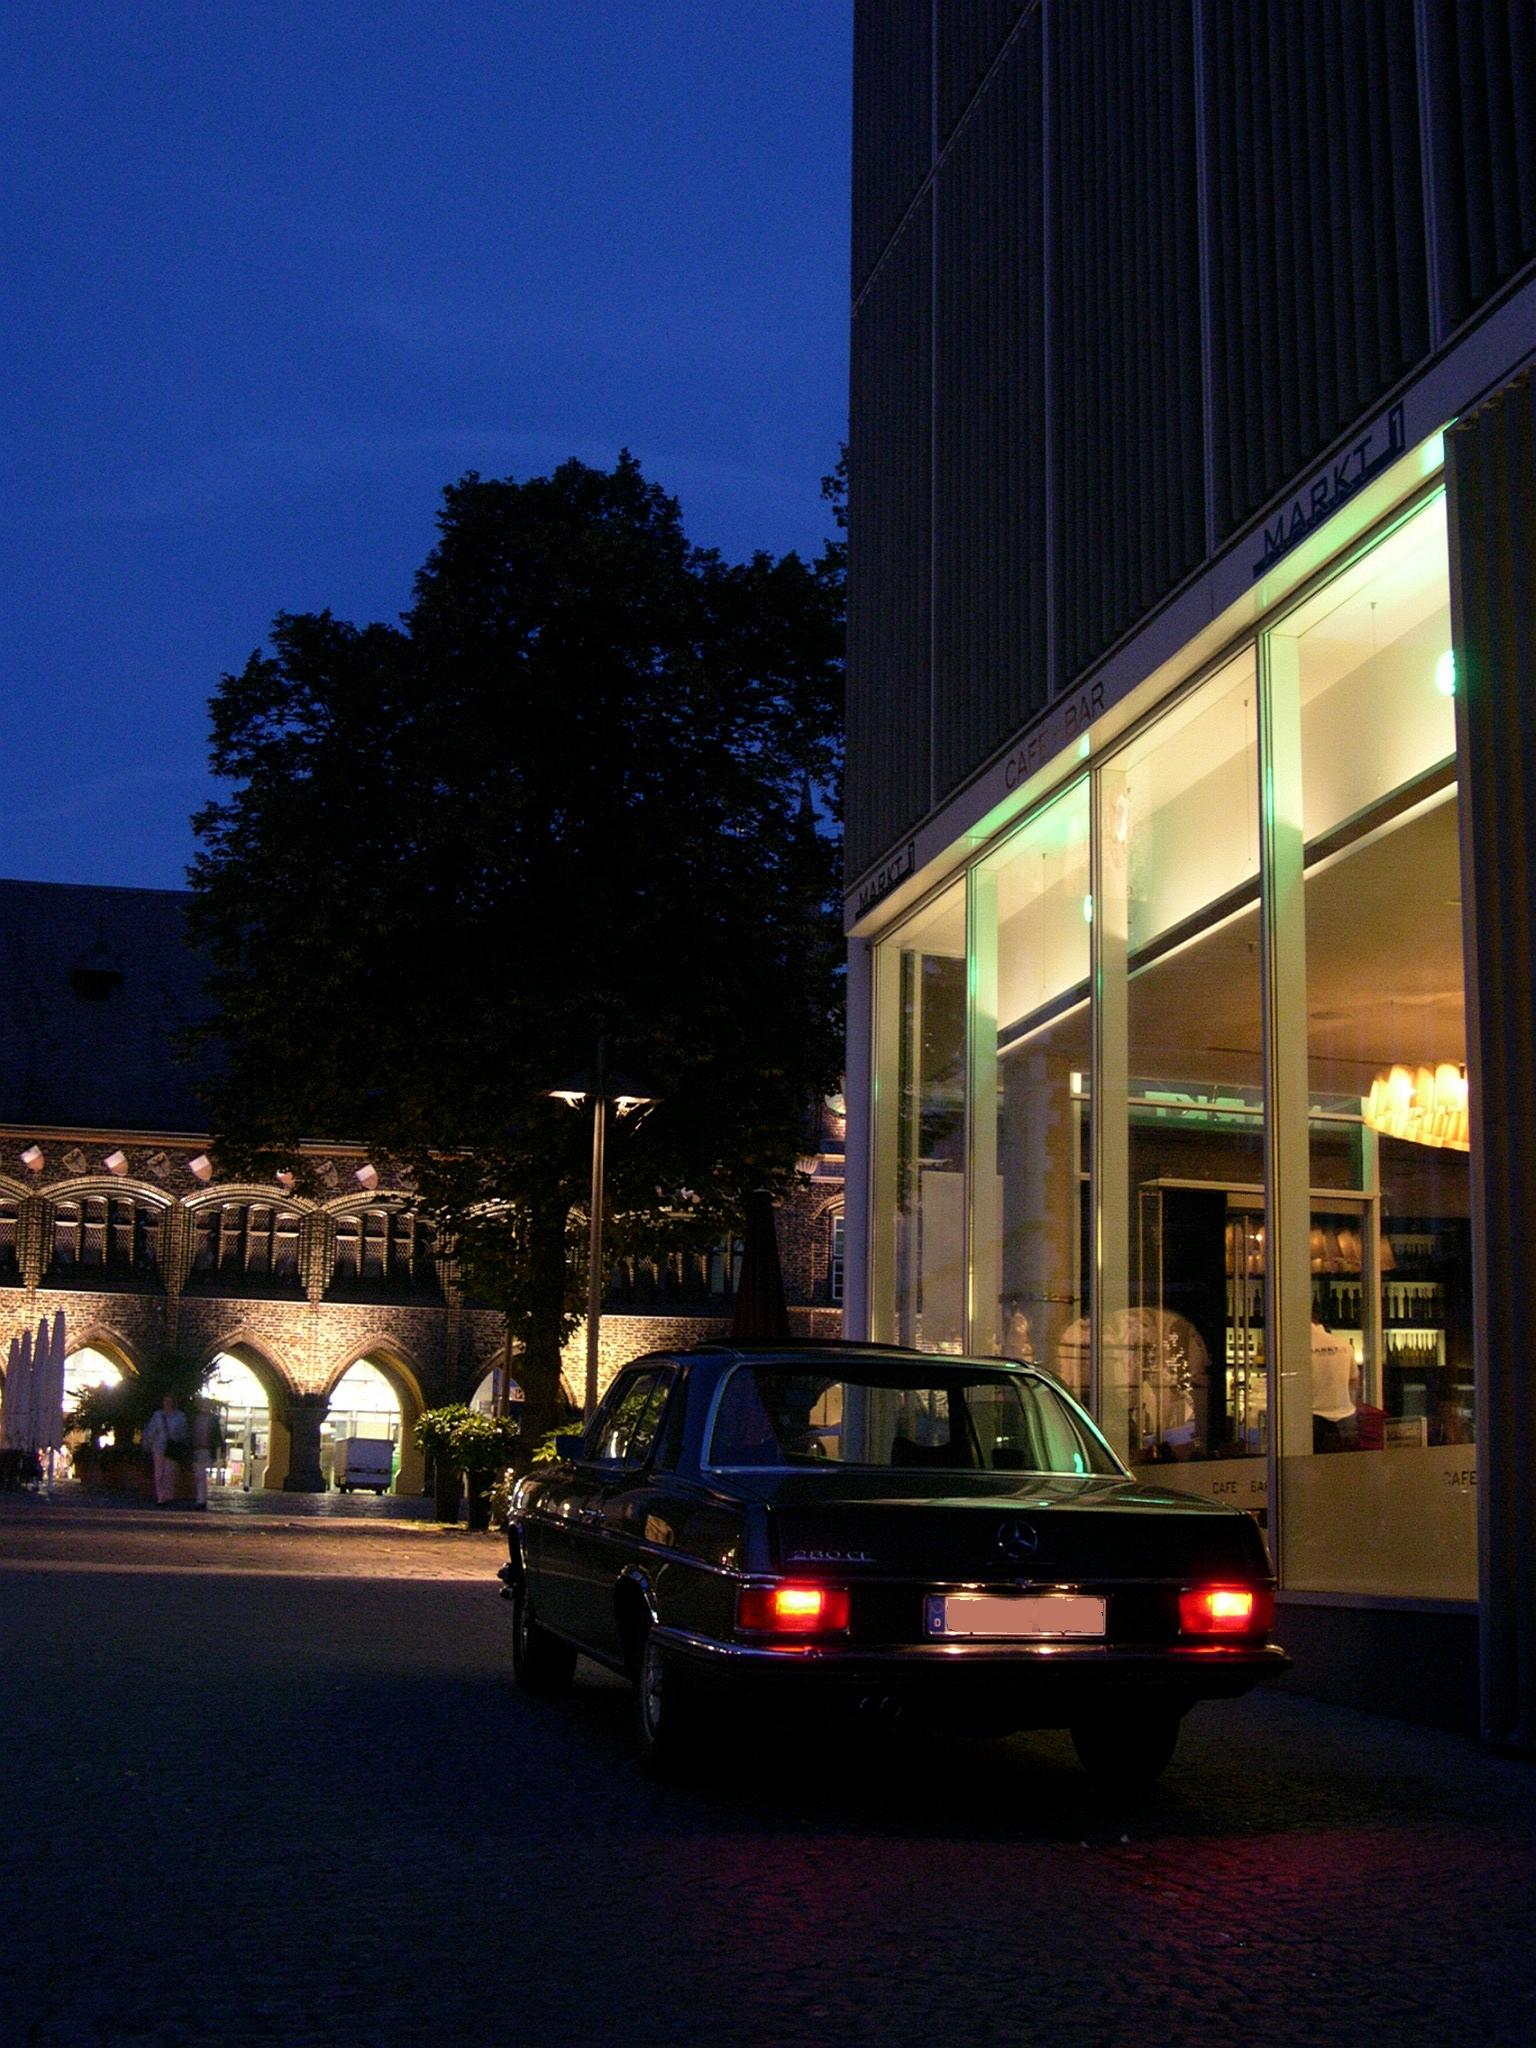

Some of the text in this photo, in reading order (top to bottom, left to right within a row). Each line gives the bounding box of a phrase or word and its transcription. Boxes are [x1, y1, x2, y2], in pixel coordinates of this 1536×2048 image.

[1263, 435, 1373, 558] MARKT
[1065, 681, 1104, 739] BAR
[859, 855, 903, 911] MARKT
[1213, 1481, 1237, 1494] CAFE
